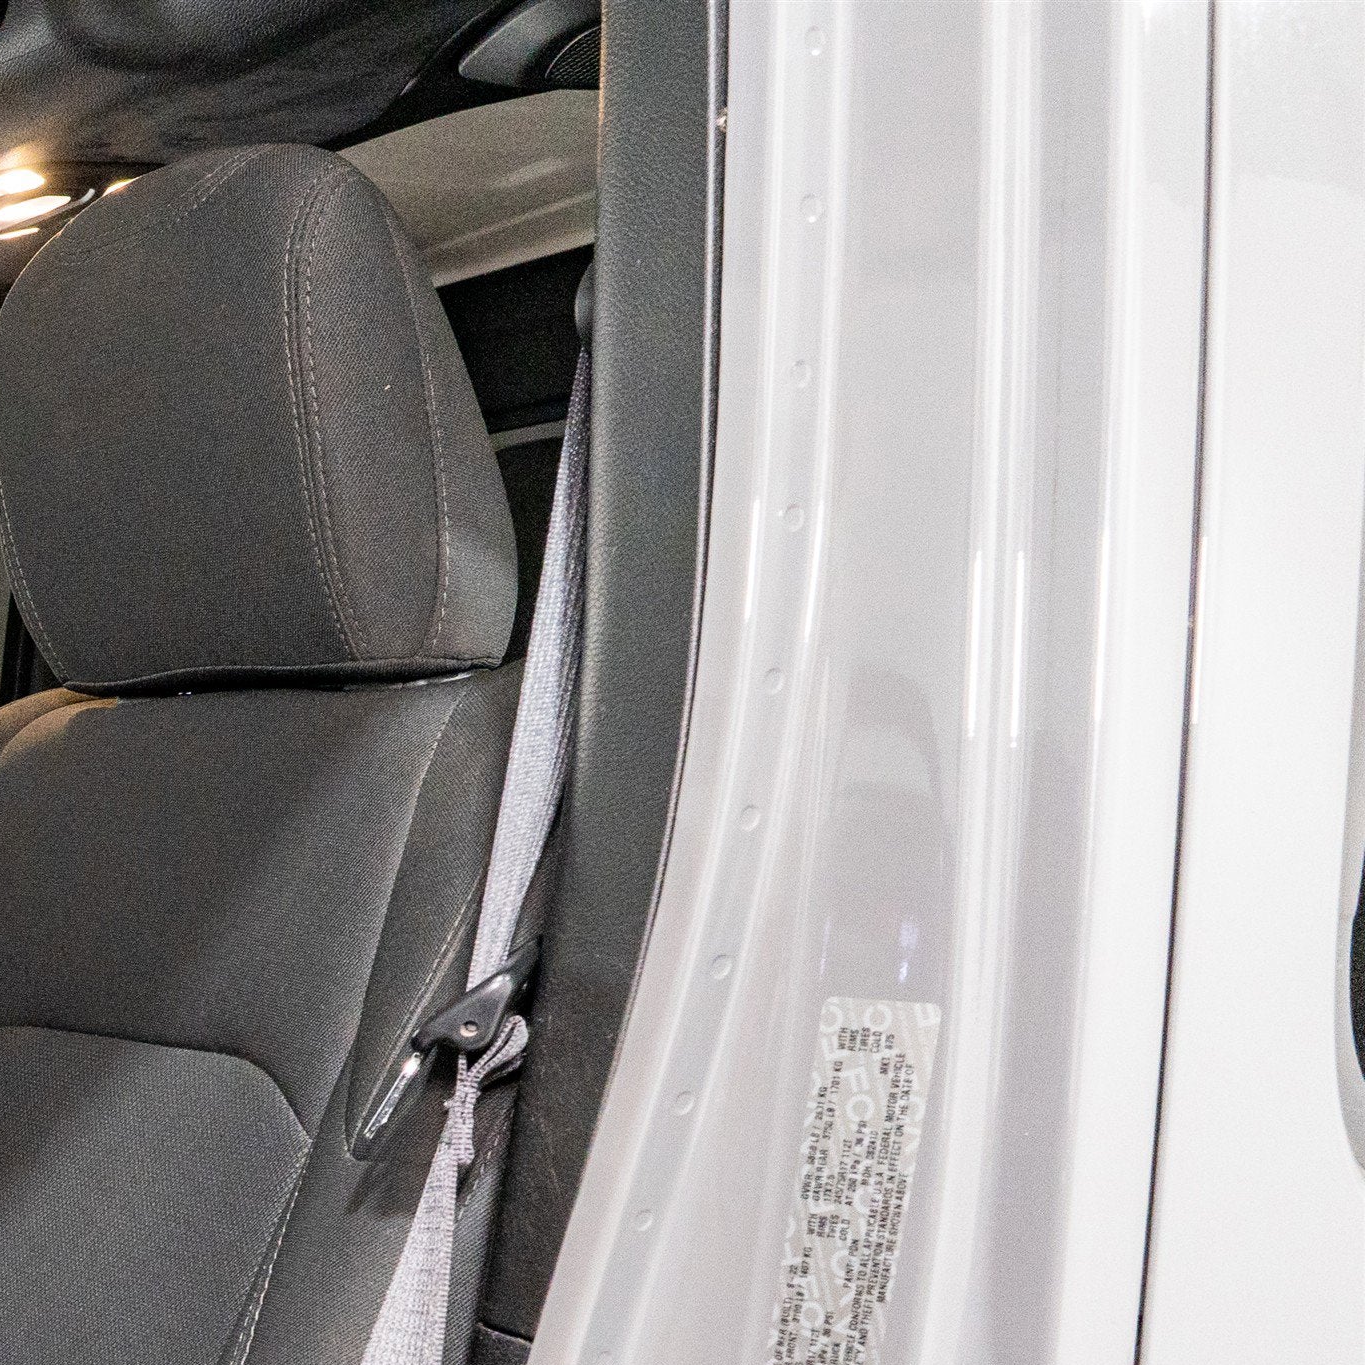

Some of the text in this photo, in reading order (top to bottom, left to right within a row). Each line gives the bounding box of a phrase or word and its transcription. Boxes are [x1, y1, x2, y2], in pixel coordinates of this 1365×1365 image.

[889, 1052, 905, 1089] VEHICLE
[884, 1090, 898, 1123] MOTOR
[876, 1124, 893, 1165] FEDERAL
[862, 1197, 880, 1249] APPLICABLE
[875, 1172, 908, 1304] MANUFACTURE SHOWN ABOVE
[856, 1326, 868, 1346] AND
[865, 1240, 884, 1296] PREVENTION
[875, 1186, 893, 1240] STANDARDS
[856, 1269, 867, 1282] TO
[859, 1251, 870, 1268] ALL
[848, 1283, 865, 1331] CONFORMS
